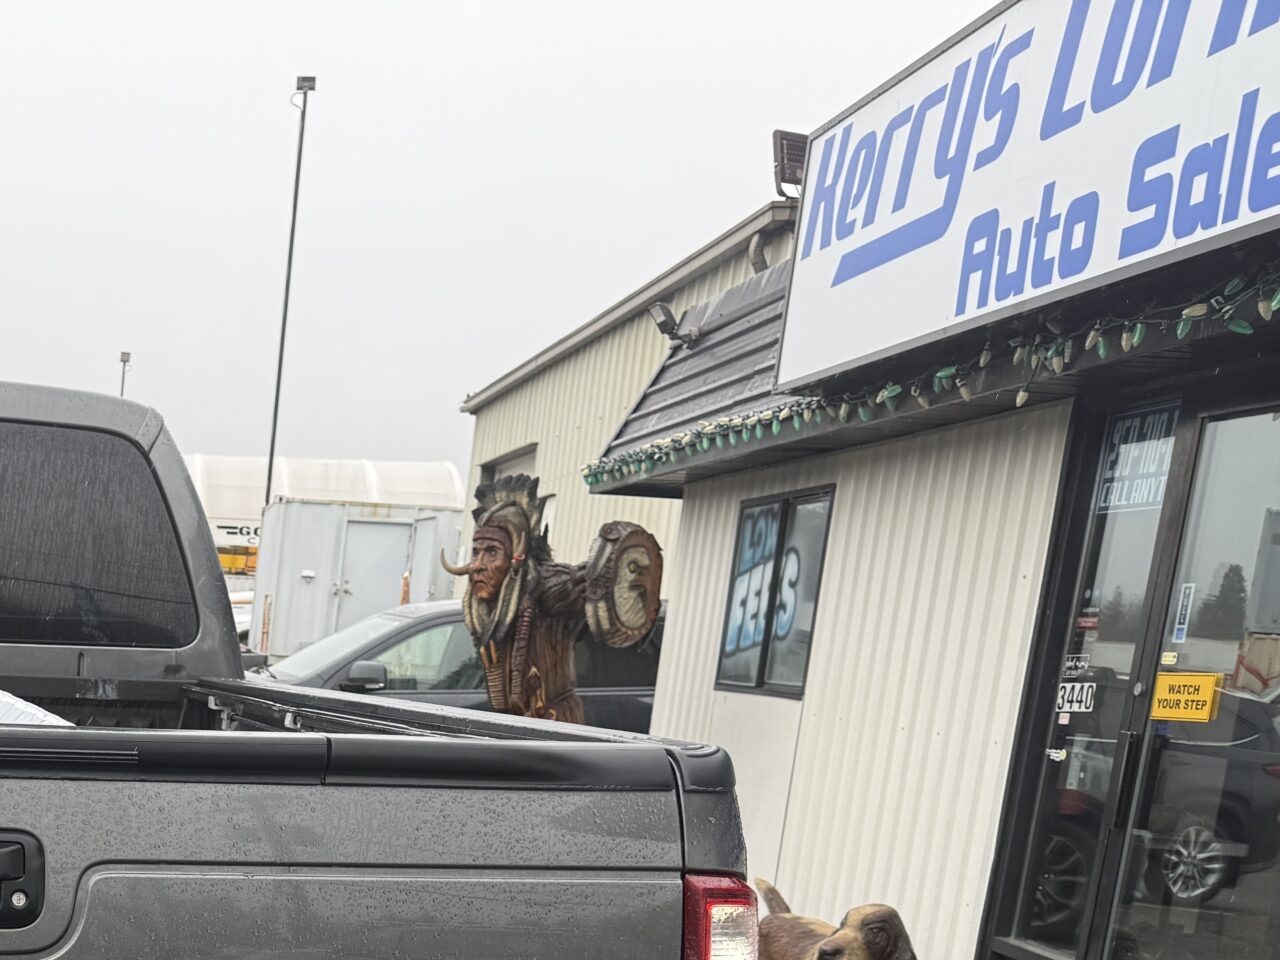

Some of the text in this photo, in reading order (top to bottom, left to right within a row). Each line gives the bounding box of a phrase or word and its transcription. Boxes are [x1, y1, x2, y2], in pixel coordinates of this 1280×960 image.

[800, 24, 1035, 288] Kerry's
[954, 87, 1280, 317] Auto Sale
[1099, 480, 1130, 507] CALL
[1057, 684, 1095, 710] 3440
[1168, 684, 1201, 696] WATCH
[1157, 698, 1207, 711] YOUR STEP
